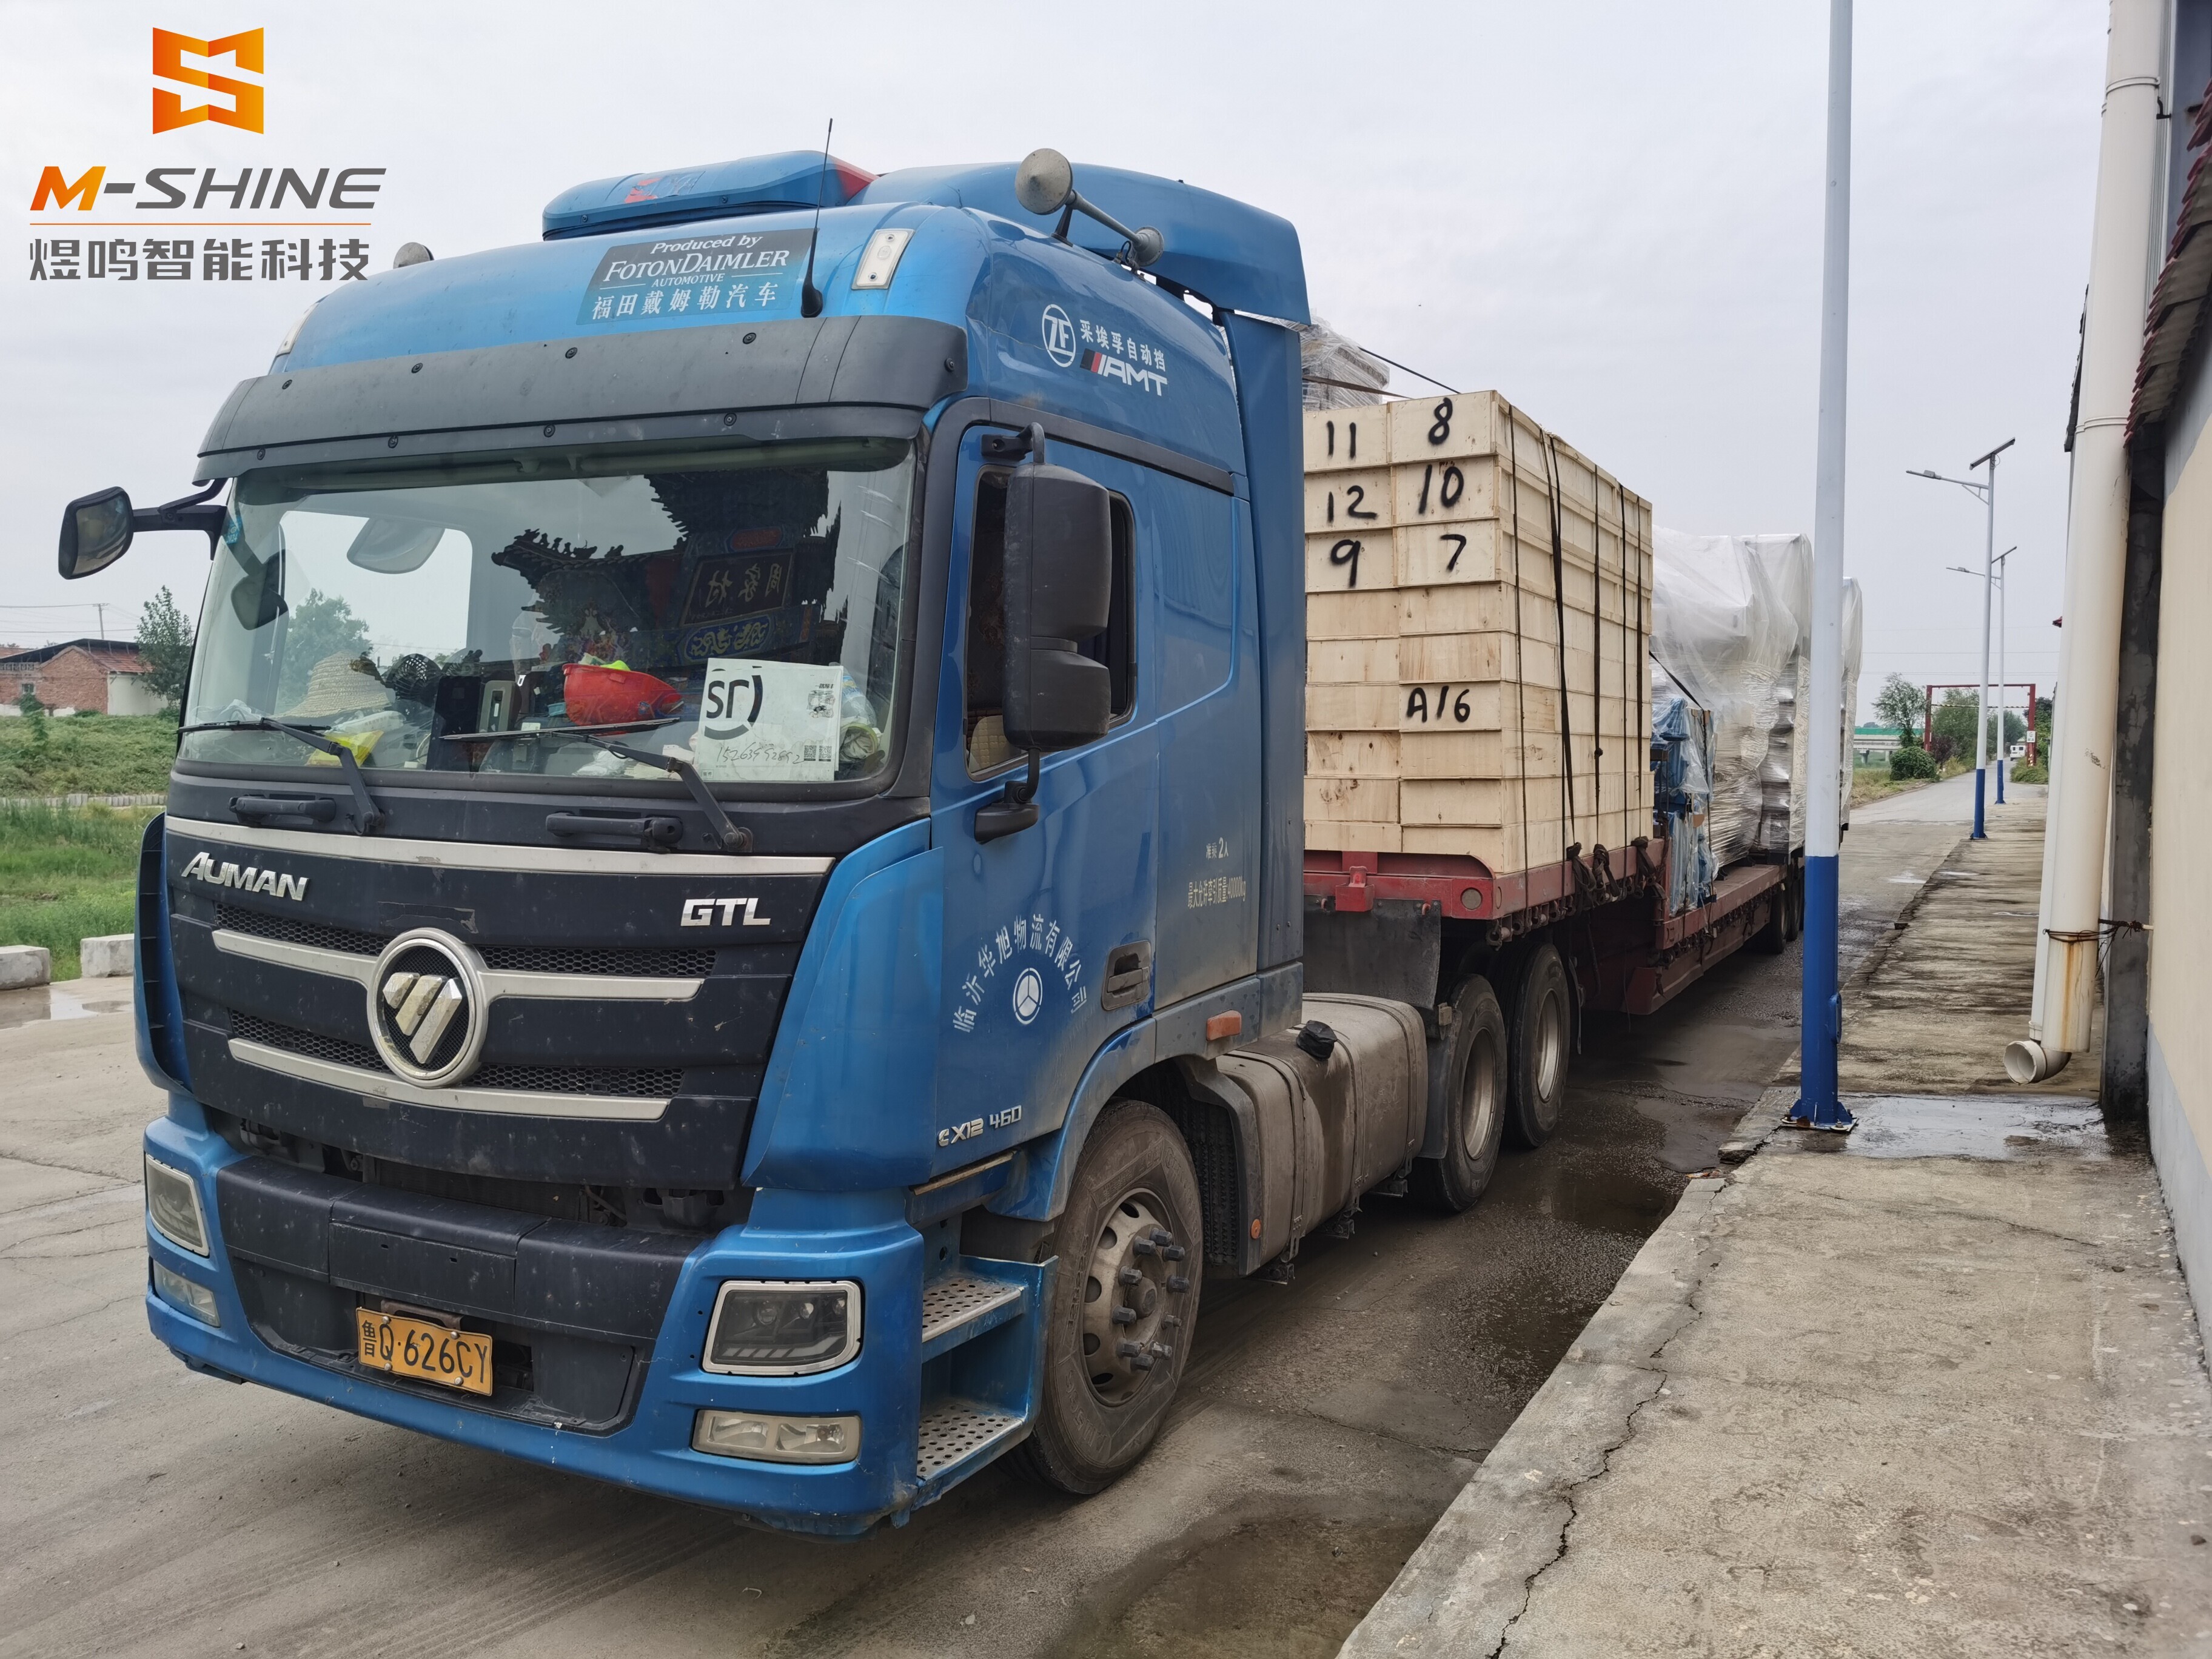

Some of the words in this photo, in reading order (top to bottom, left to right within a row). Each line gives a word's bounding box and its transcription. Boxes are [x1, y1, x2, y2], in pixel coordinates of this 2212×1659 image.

[649, 235, 732, 255] Produced
[736, 233, 764, 249] by
[651, 272, 725, 288] AUTOMOTIVE
[591, 281, 779, 320] 福田戴姆勒汽车
[1079, 319, 1167, 372] 采埃孚自动挡
[1326, 420, 1357, 459] 11
[1429, 397, 1453, 446] 8
[1327, 484, 1378, 523] 12
[1418, 464, 1464, 515] 10
[1330, 539, 1362, 588] 9
[1439, 534, 1467, 571] 7
[181, 851, 309, 902] AUMAN
[680, 897, 772, 927] GTL
[953, 913, 1088, 1033] 临沂华旭物流有限公司
[989, 1105, 1022, 1129] 460
